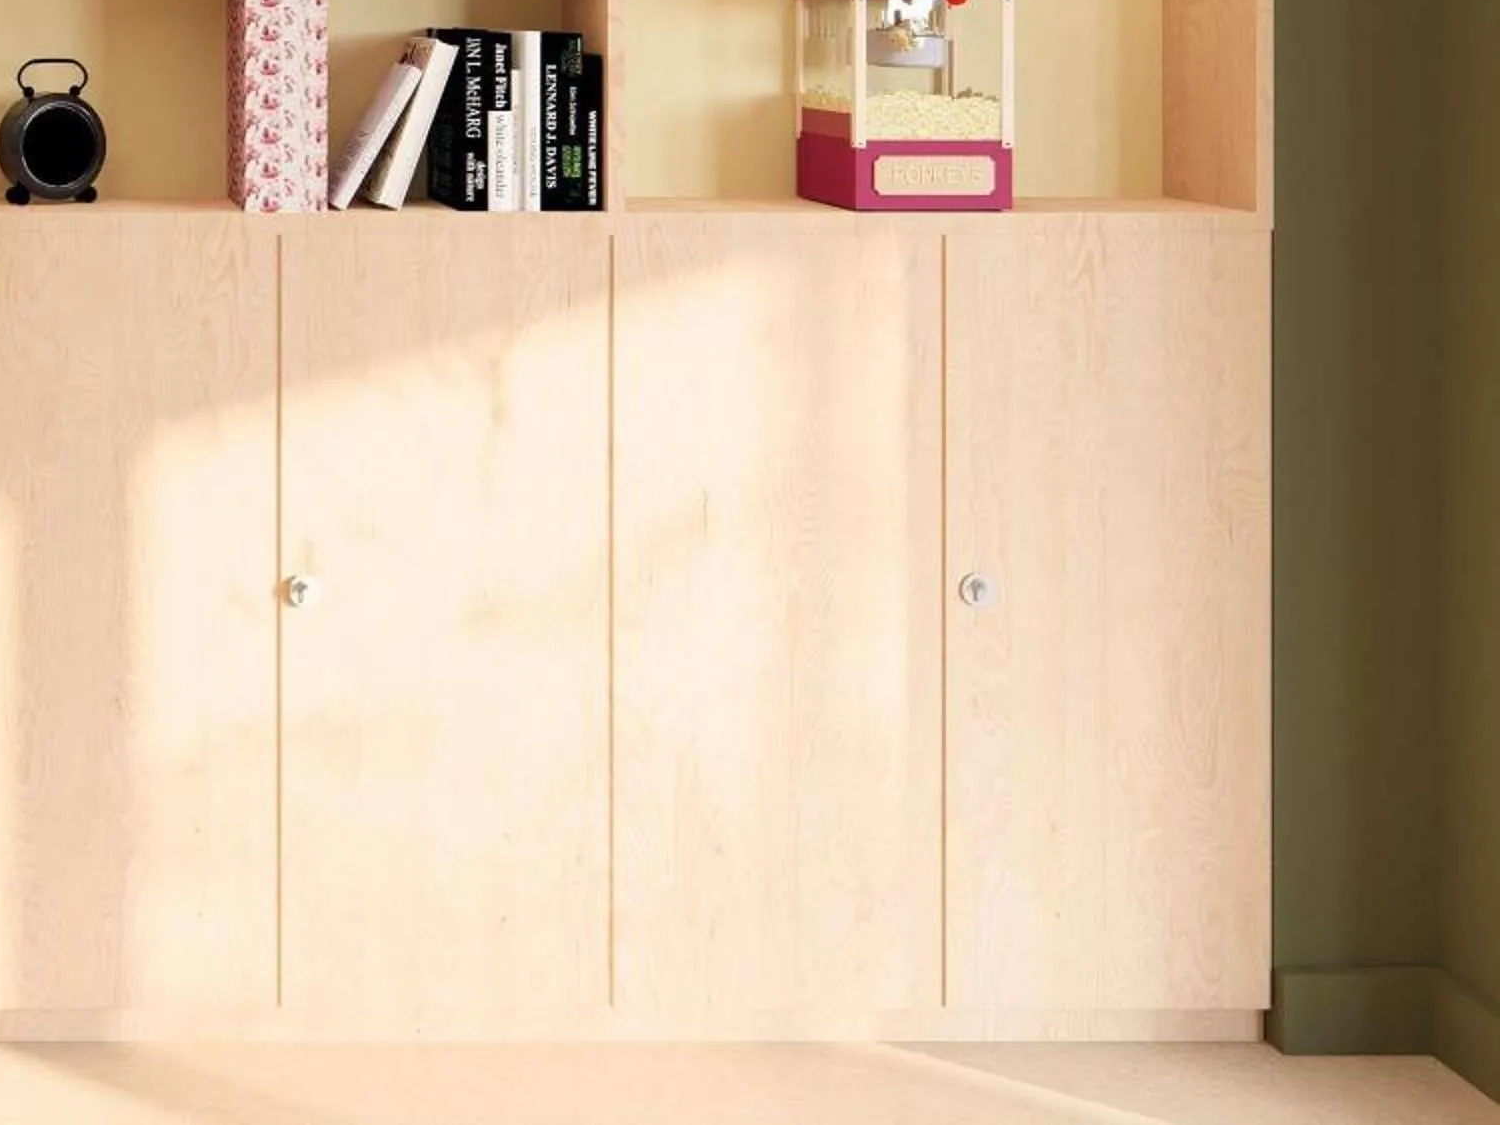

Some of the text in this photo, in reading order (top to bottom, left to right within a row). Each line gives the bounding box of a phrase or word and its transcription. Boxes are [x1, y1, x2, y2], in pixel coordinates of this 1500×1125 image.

[465, 76, 482, 139] McHARG
[494, 42, 507, 108] Janet Fitch
[545, 63, 557, 189] LENNARD J. DAVIS
